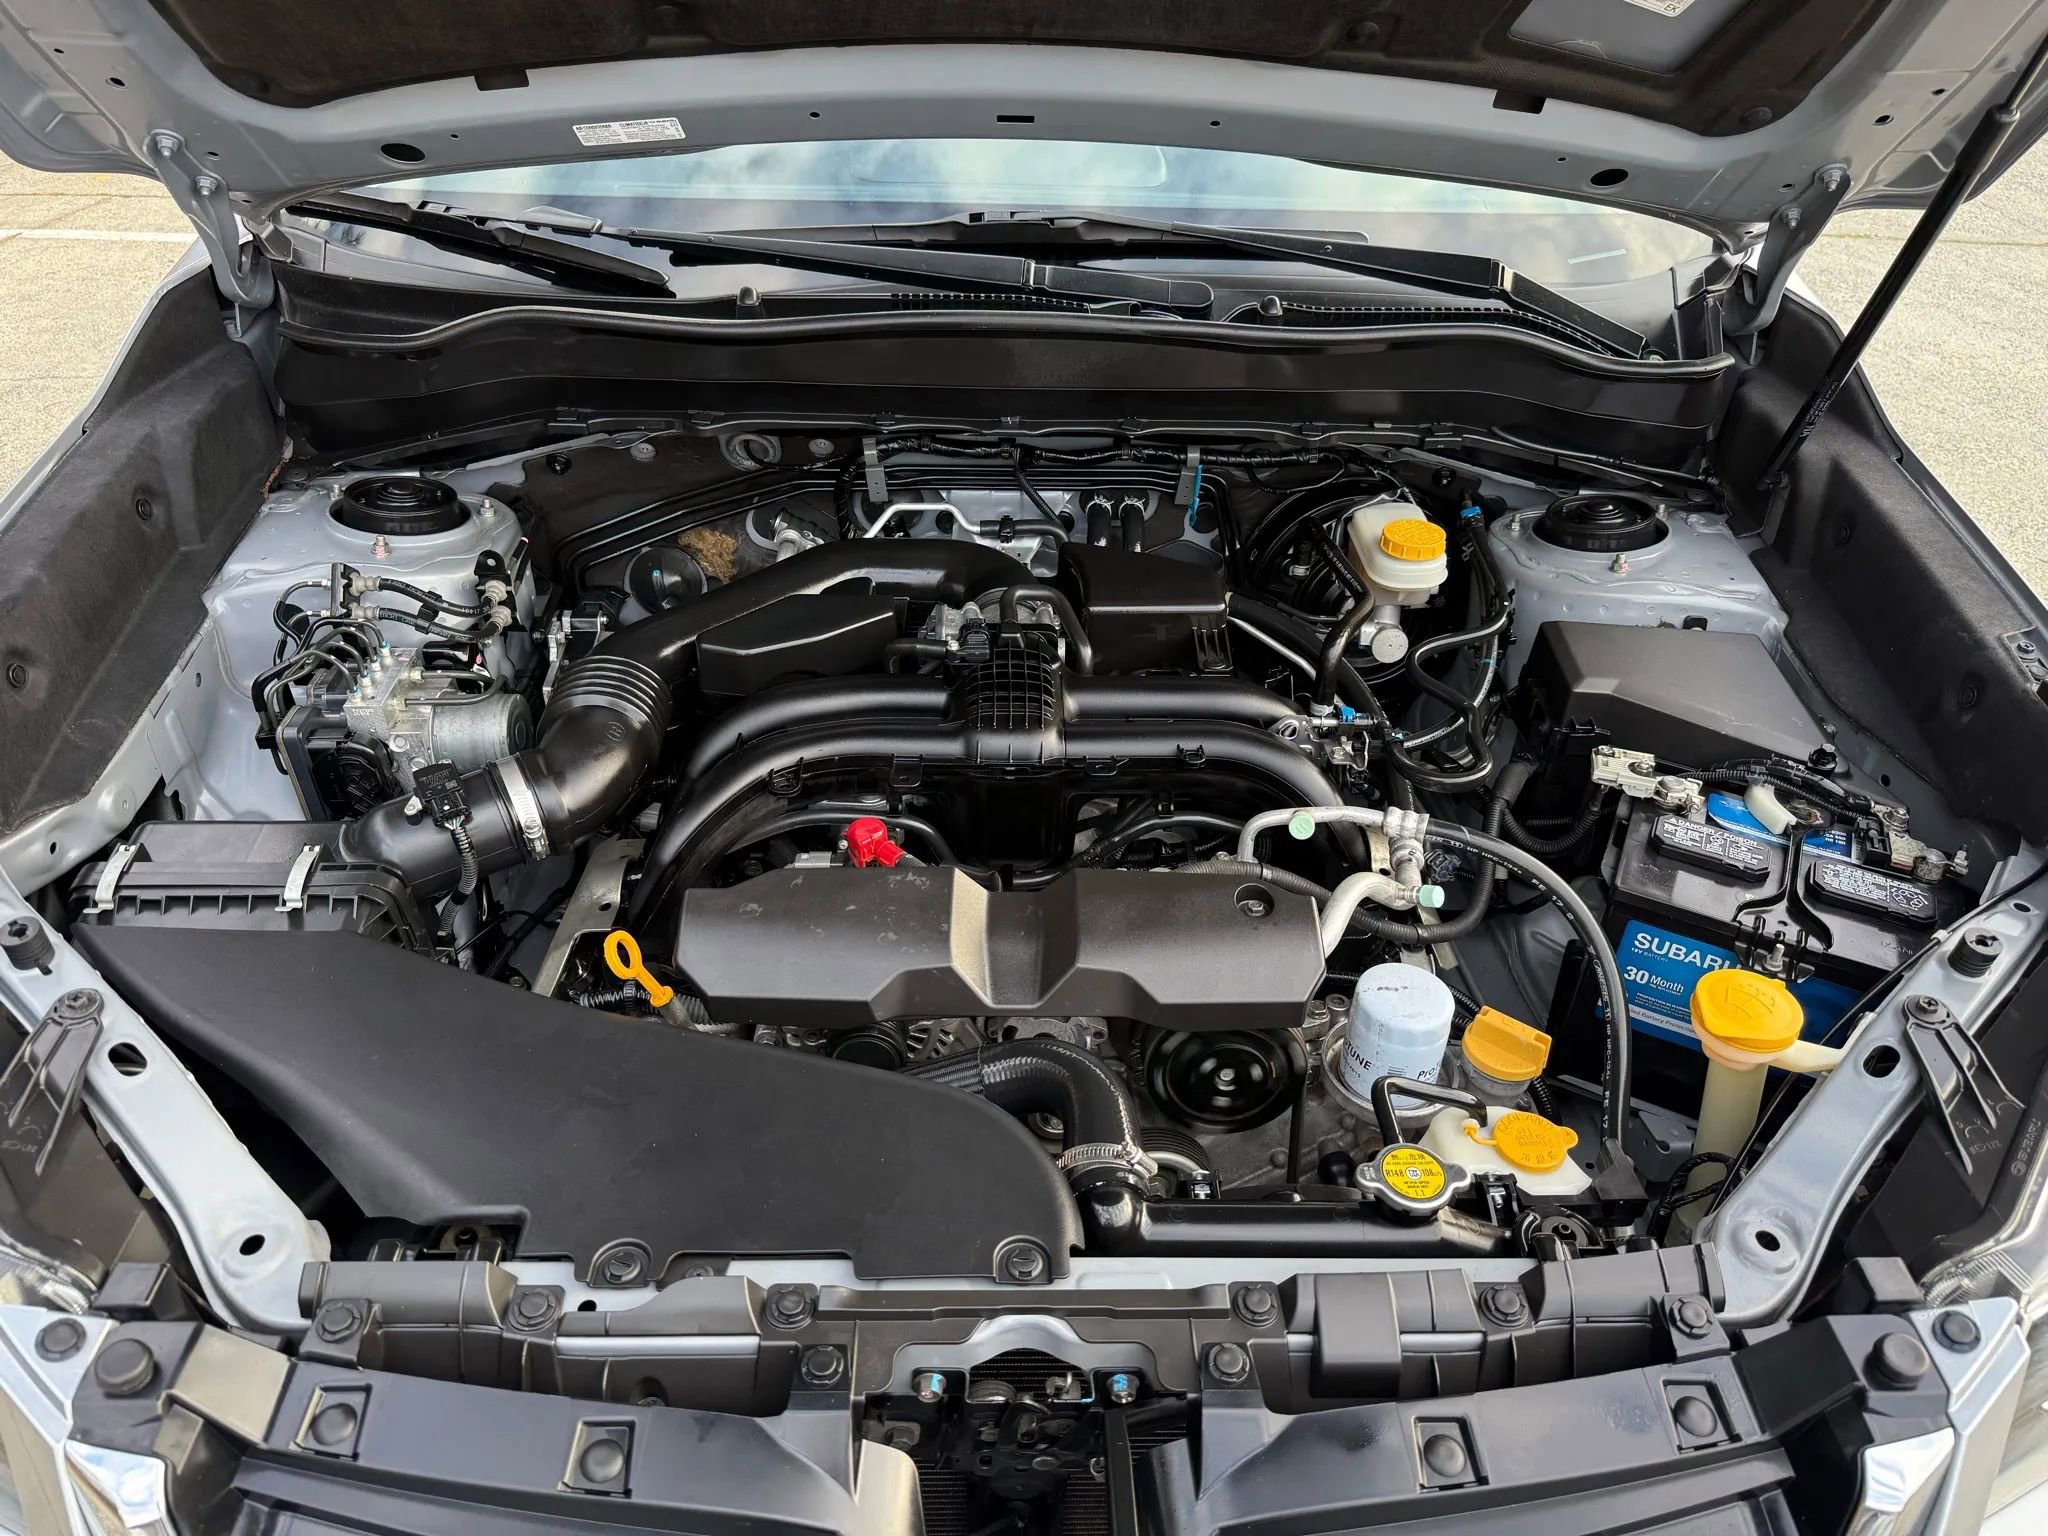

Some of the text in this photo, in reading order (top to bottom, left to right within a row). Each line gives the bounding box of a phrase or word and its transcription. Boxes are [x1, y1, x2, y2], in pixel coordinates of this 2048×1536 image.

[1664, 4, 1680, 13] EK
[1678, 820, 1715, 834] DANGER
[1722, 832, 1758, 846] POISON
[1624, 965, 1684, 993] 30 Month
[1641, 1011, 1665, 1024] Battery
[1384, 1169, 1404, 1178] R148
